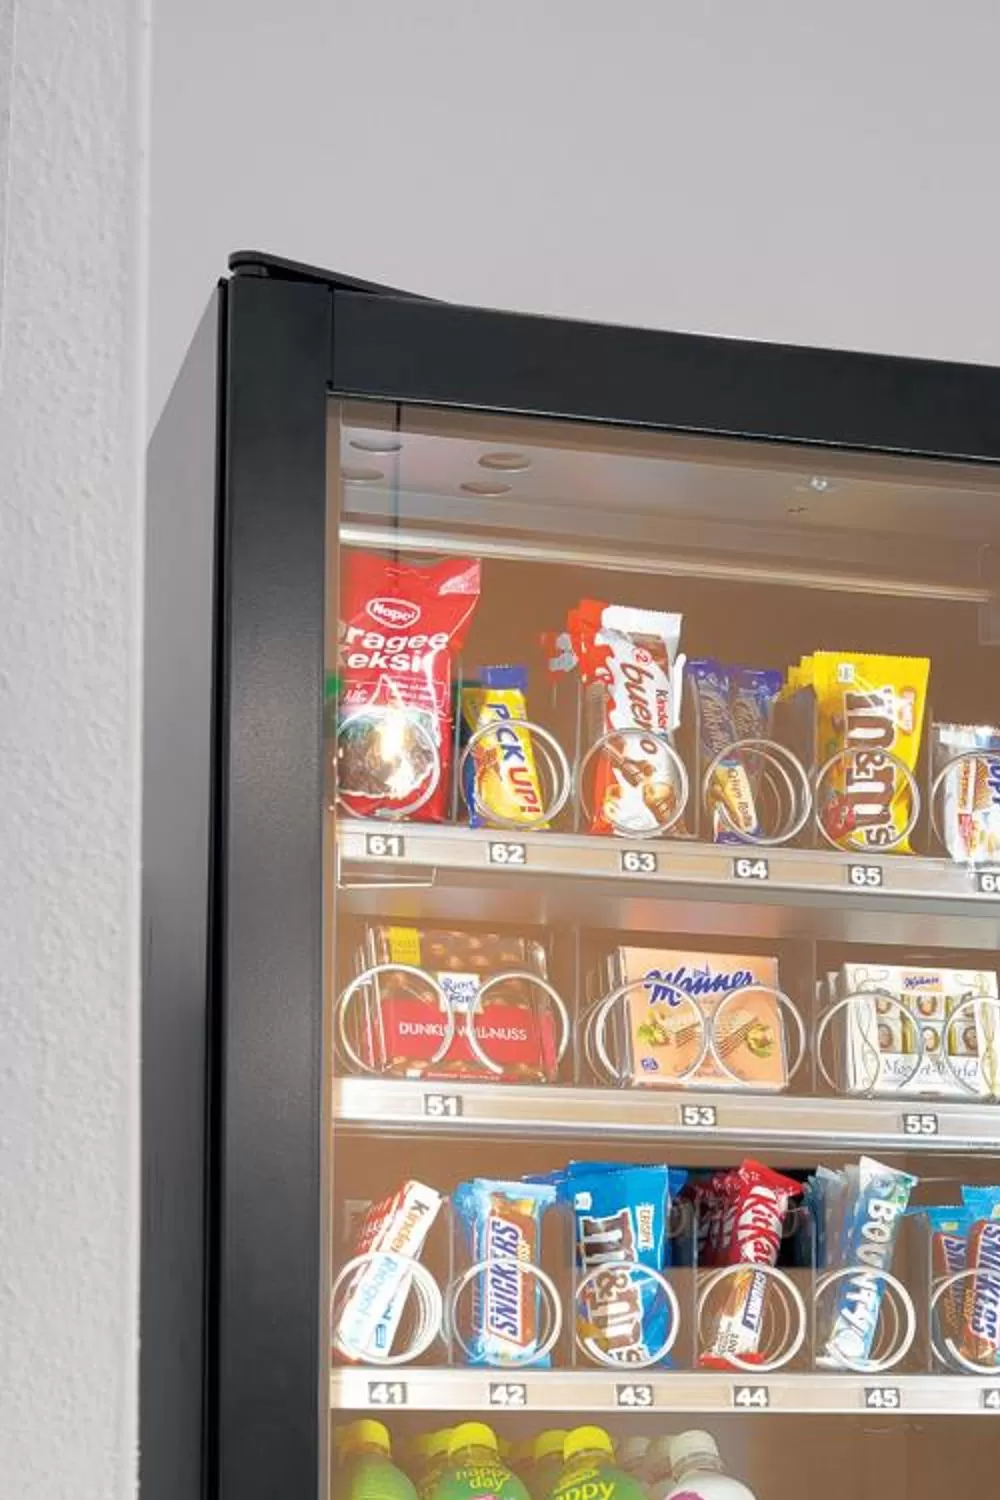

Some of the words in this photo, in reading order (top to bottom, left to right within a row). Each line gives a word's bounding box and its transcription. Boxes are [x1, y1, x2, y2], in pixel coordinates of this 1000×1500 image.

[337, 650, 422, 673] eksi
[506, 767, 543, 817] UP!
[369, 835, 401, 856] 61
[491, 844, 525, 863] 62
[623, 853, 656, 872] 63
[736, 860, 768, 879] 64
[850, 866, 882, 886] 65
[643, 965, 754, 1007] Manner
[399, 1022, 454, 1038] DUNKL
[457, 1025, 528, 1042] VLL-NUSS
[427, 1095, 459, 1116] 51
[683, 1106, 716, 1127] 53
[905, 1114, 937, 1134] 55
[370, 1383, 405, 1404] 41
[491, 1385, 525, 1405] 42
[619, 1386, 653, 1407] 43
[735, 1388, 768, 1407] 44
[867, 1389, 899, 1408] 45
[468, 1473, 506, 1492] day
